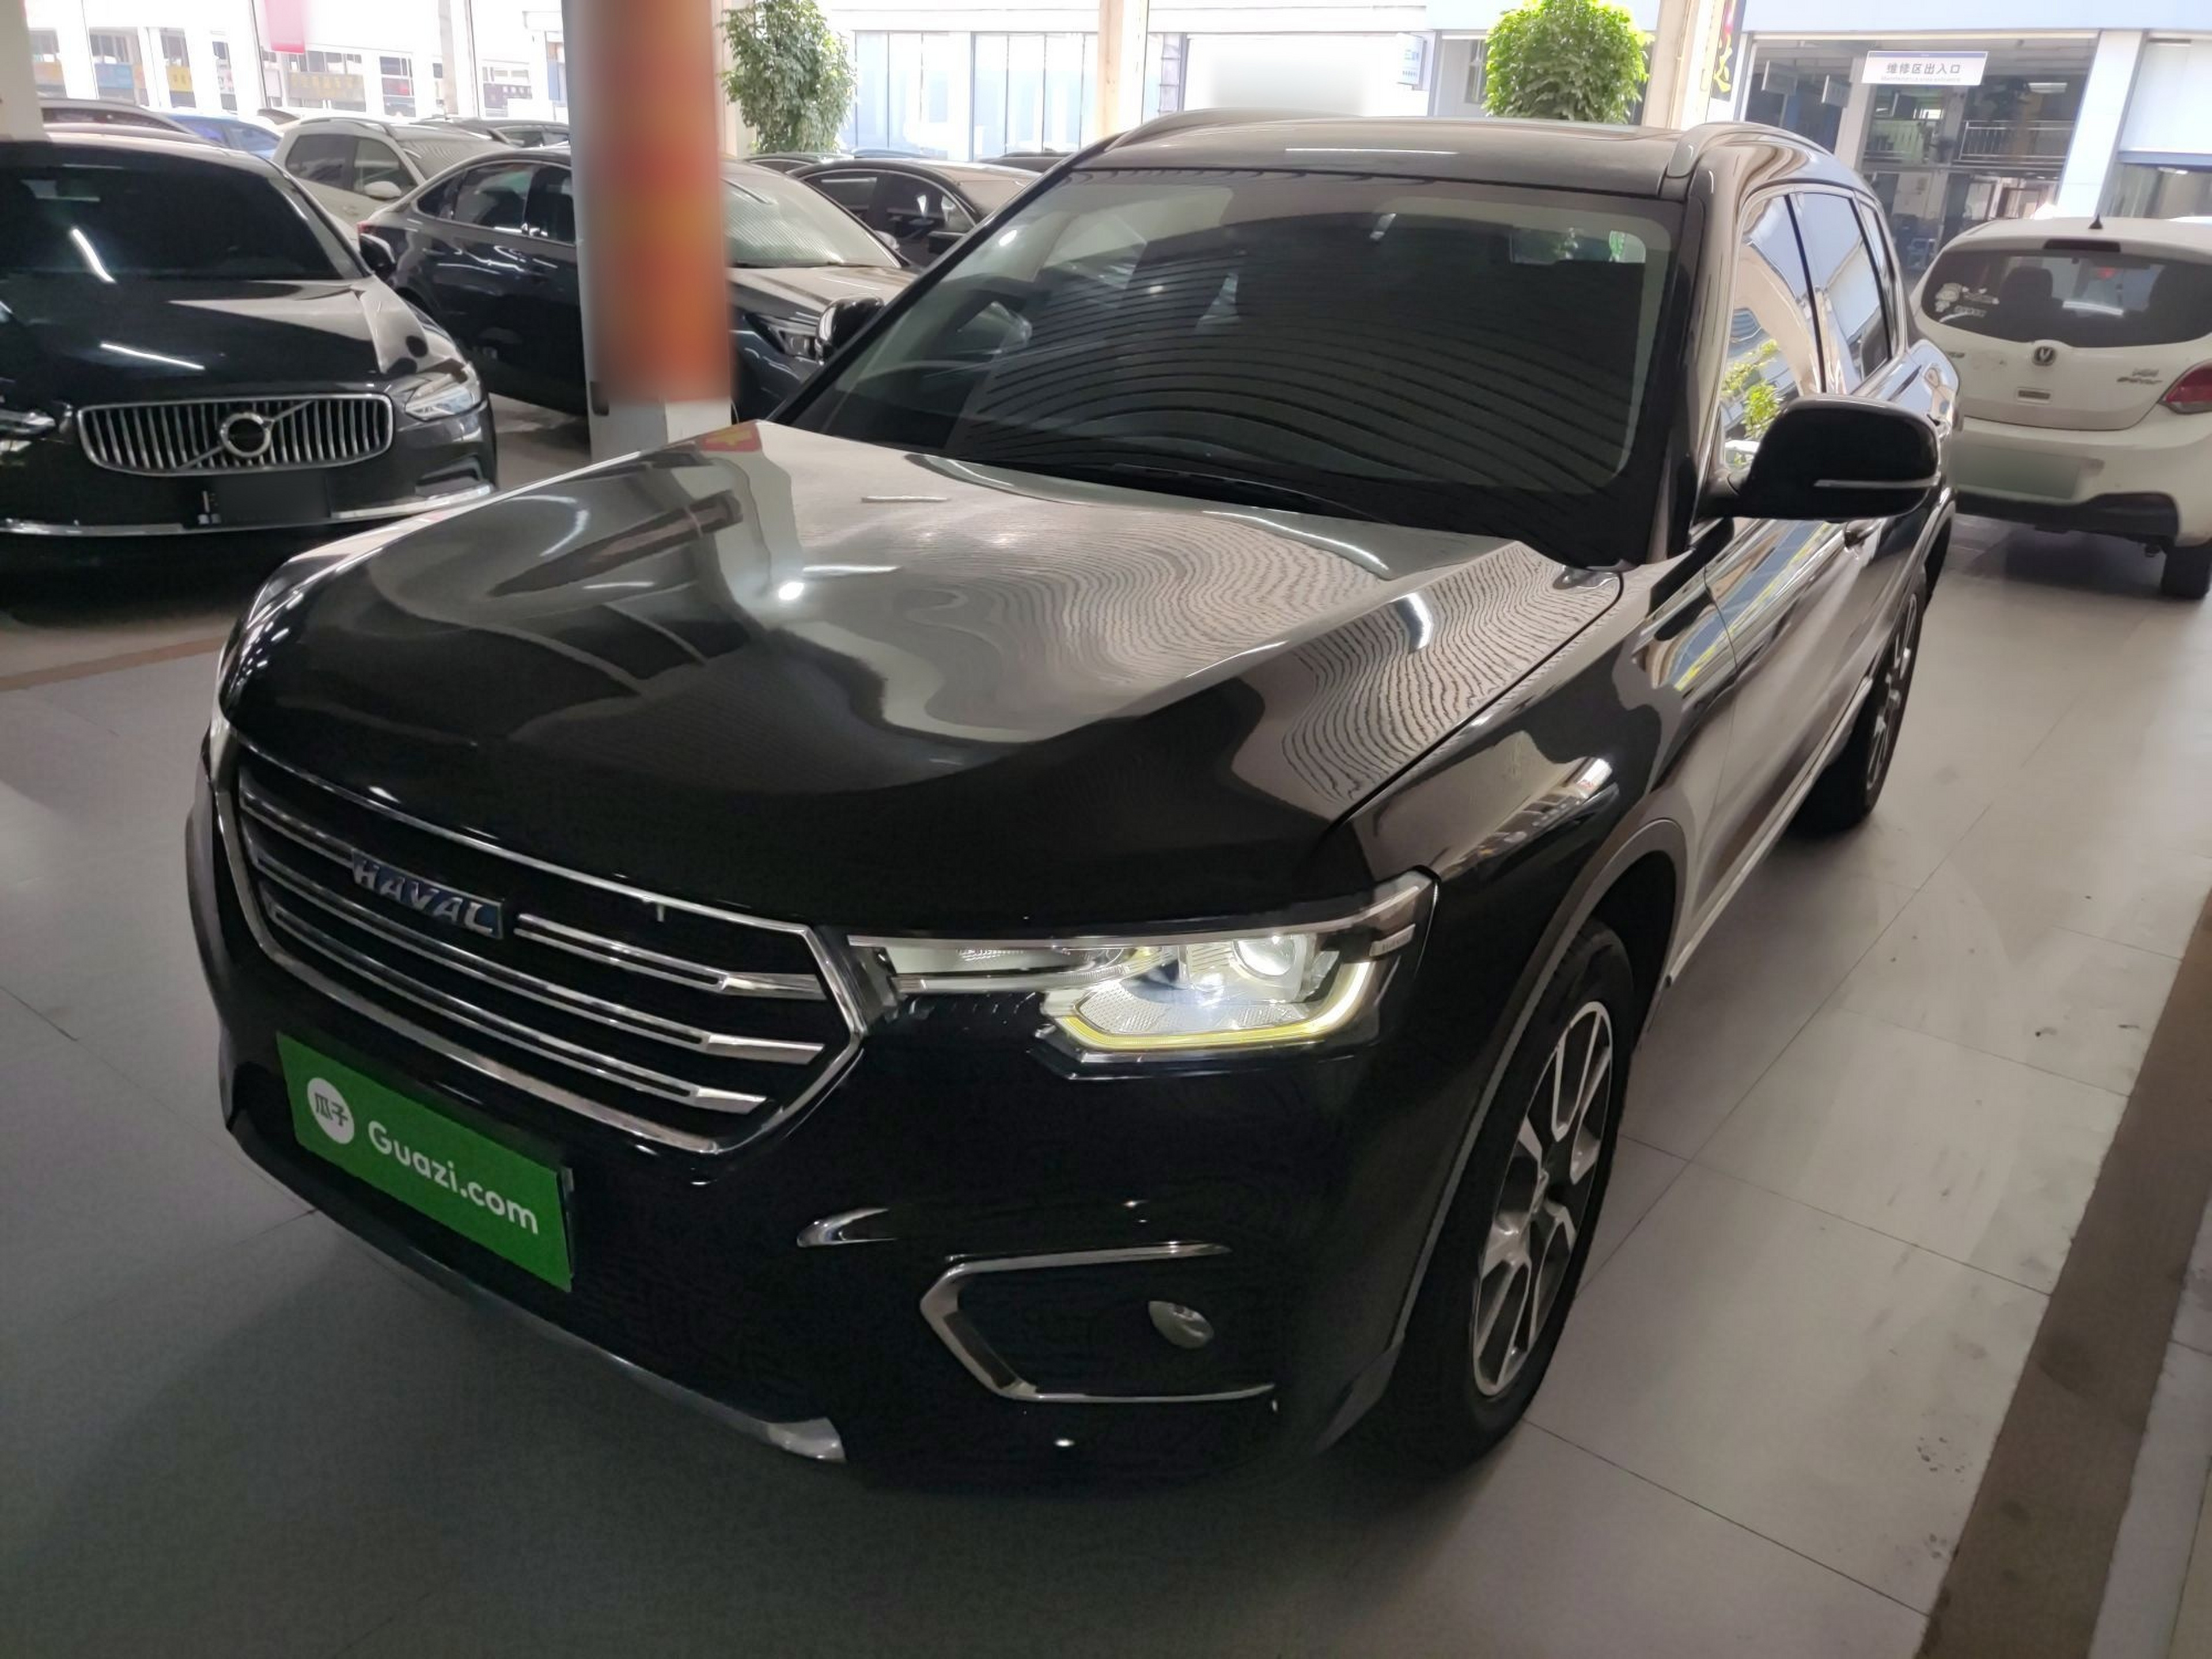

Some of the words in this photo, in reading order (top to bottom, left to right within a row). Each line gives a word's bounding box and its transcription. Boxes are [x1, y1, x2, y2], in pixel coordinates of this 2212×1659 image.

[1886, 63, 1961, 74] 维修区出入口
[352, 858, 493, 934] HAVAL
[314, 1092, 349, 1127] 瓜子
[368, 1120, 539, 1235] Guazi.com
